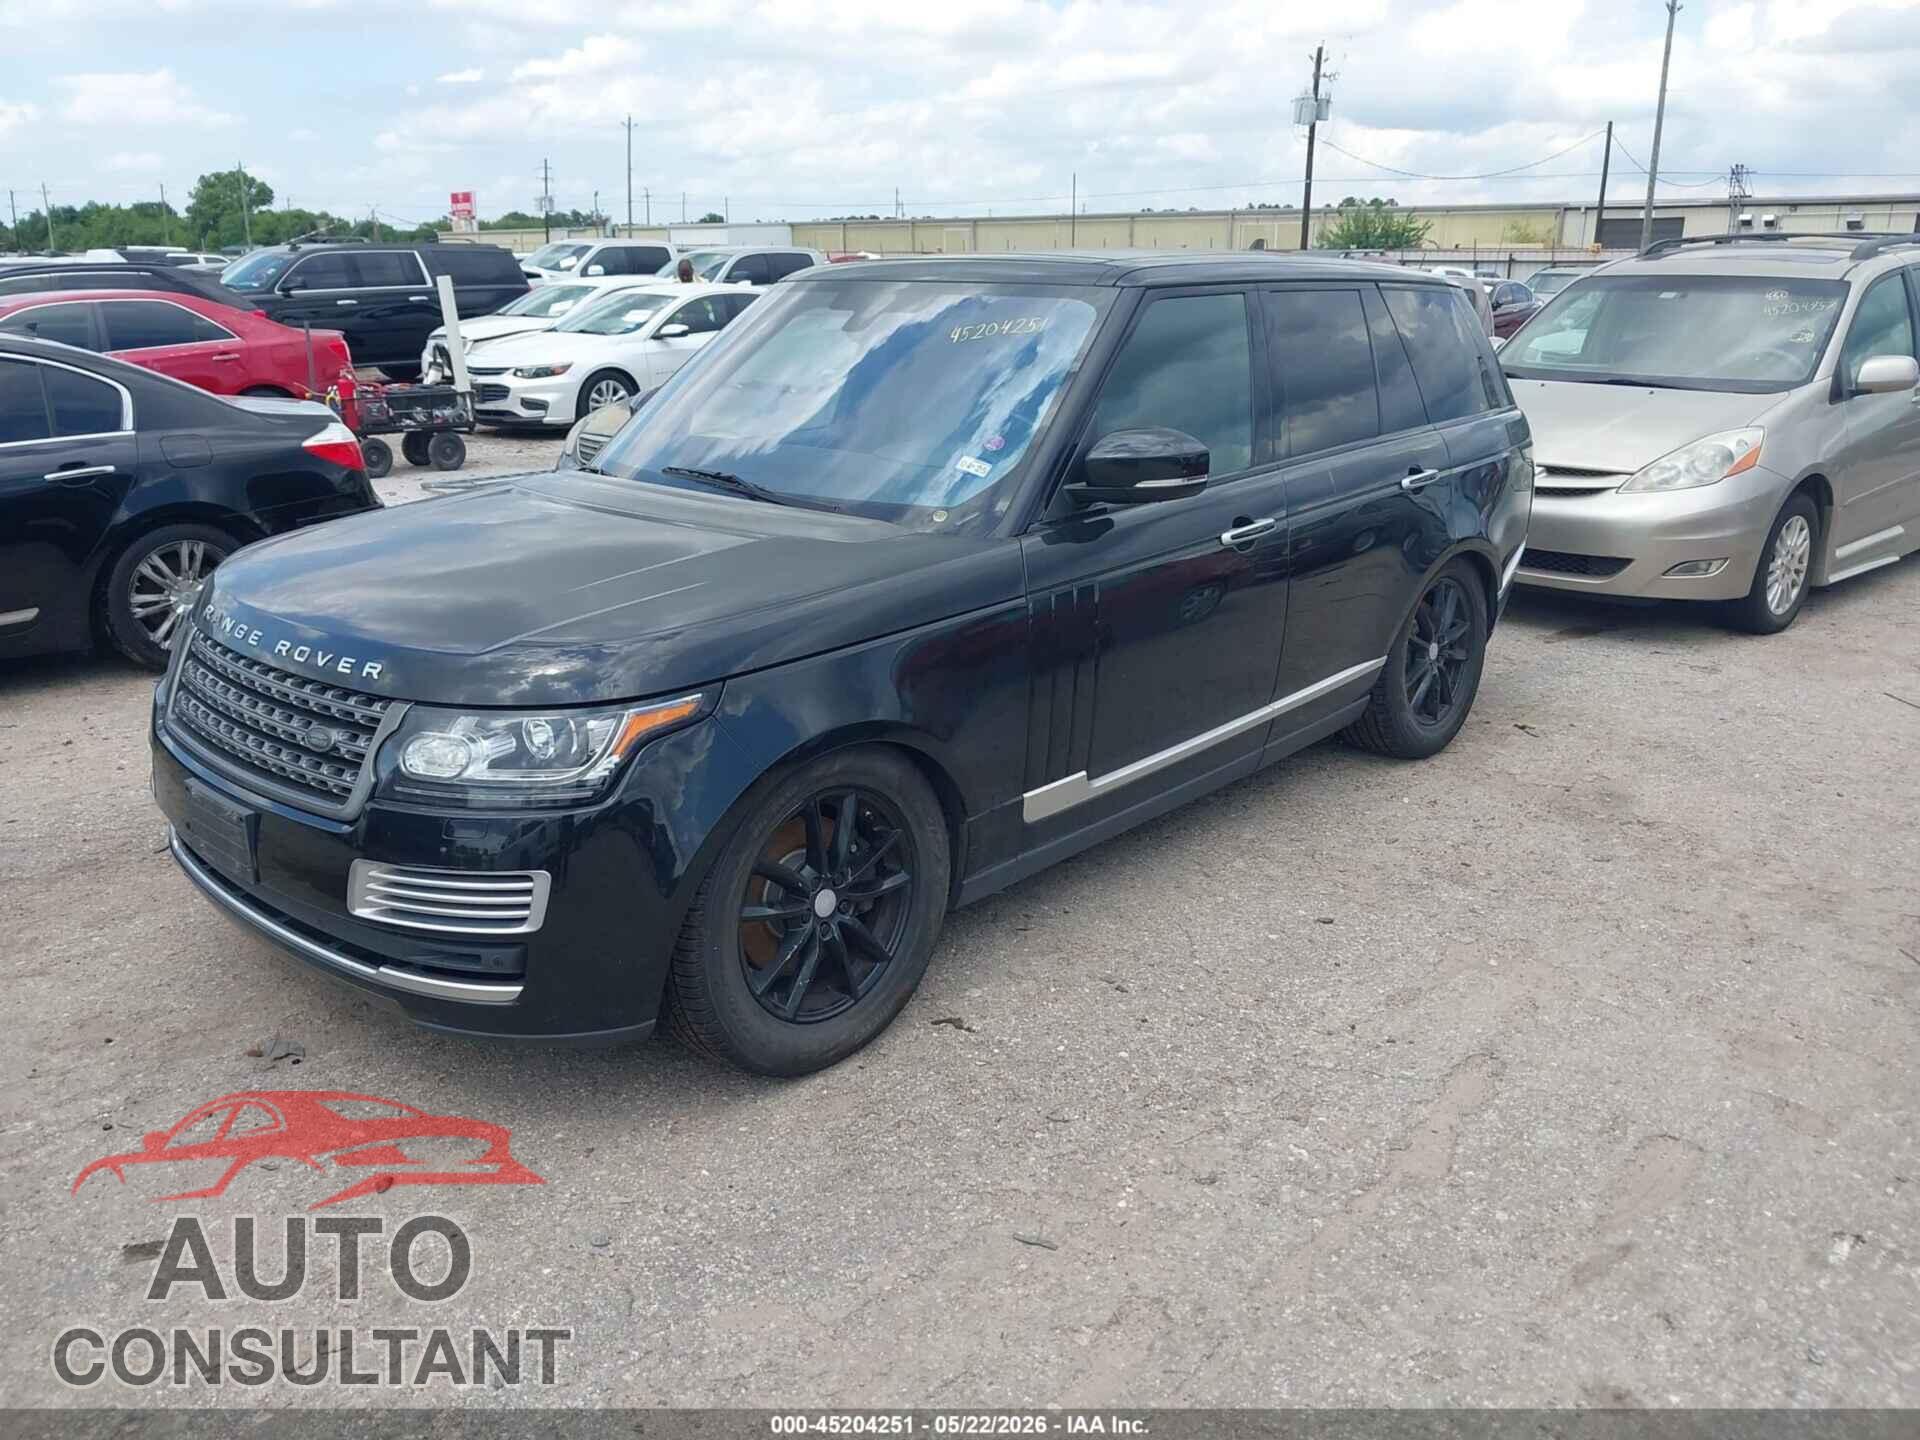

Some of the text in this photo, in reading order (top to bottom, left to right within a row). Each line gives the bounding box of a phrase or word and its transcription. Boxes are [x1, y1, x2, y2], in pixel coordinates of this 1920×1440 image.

[950, 317, 1048, 343] 45204251
[203, 604, 383, 680] RANGE ROVER
